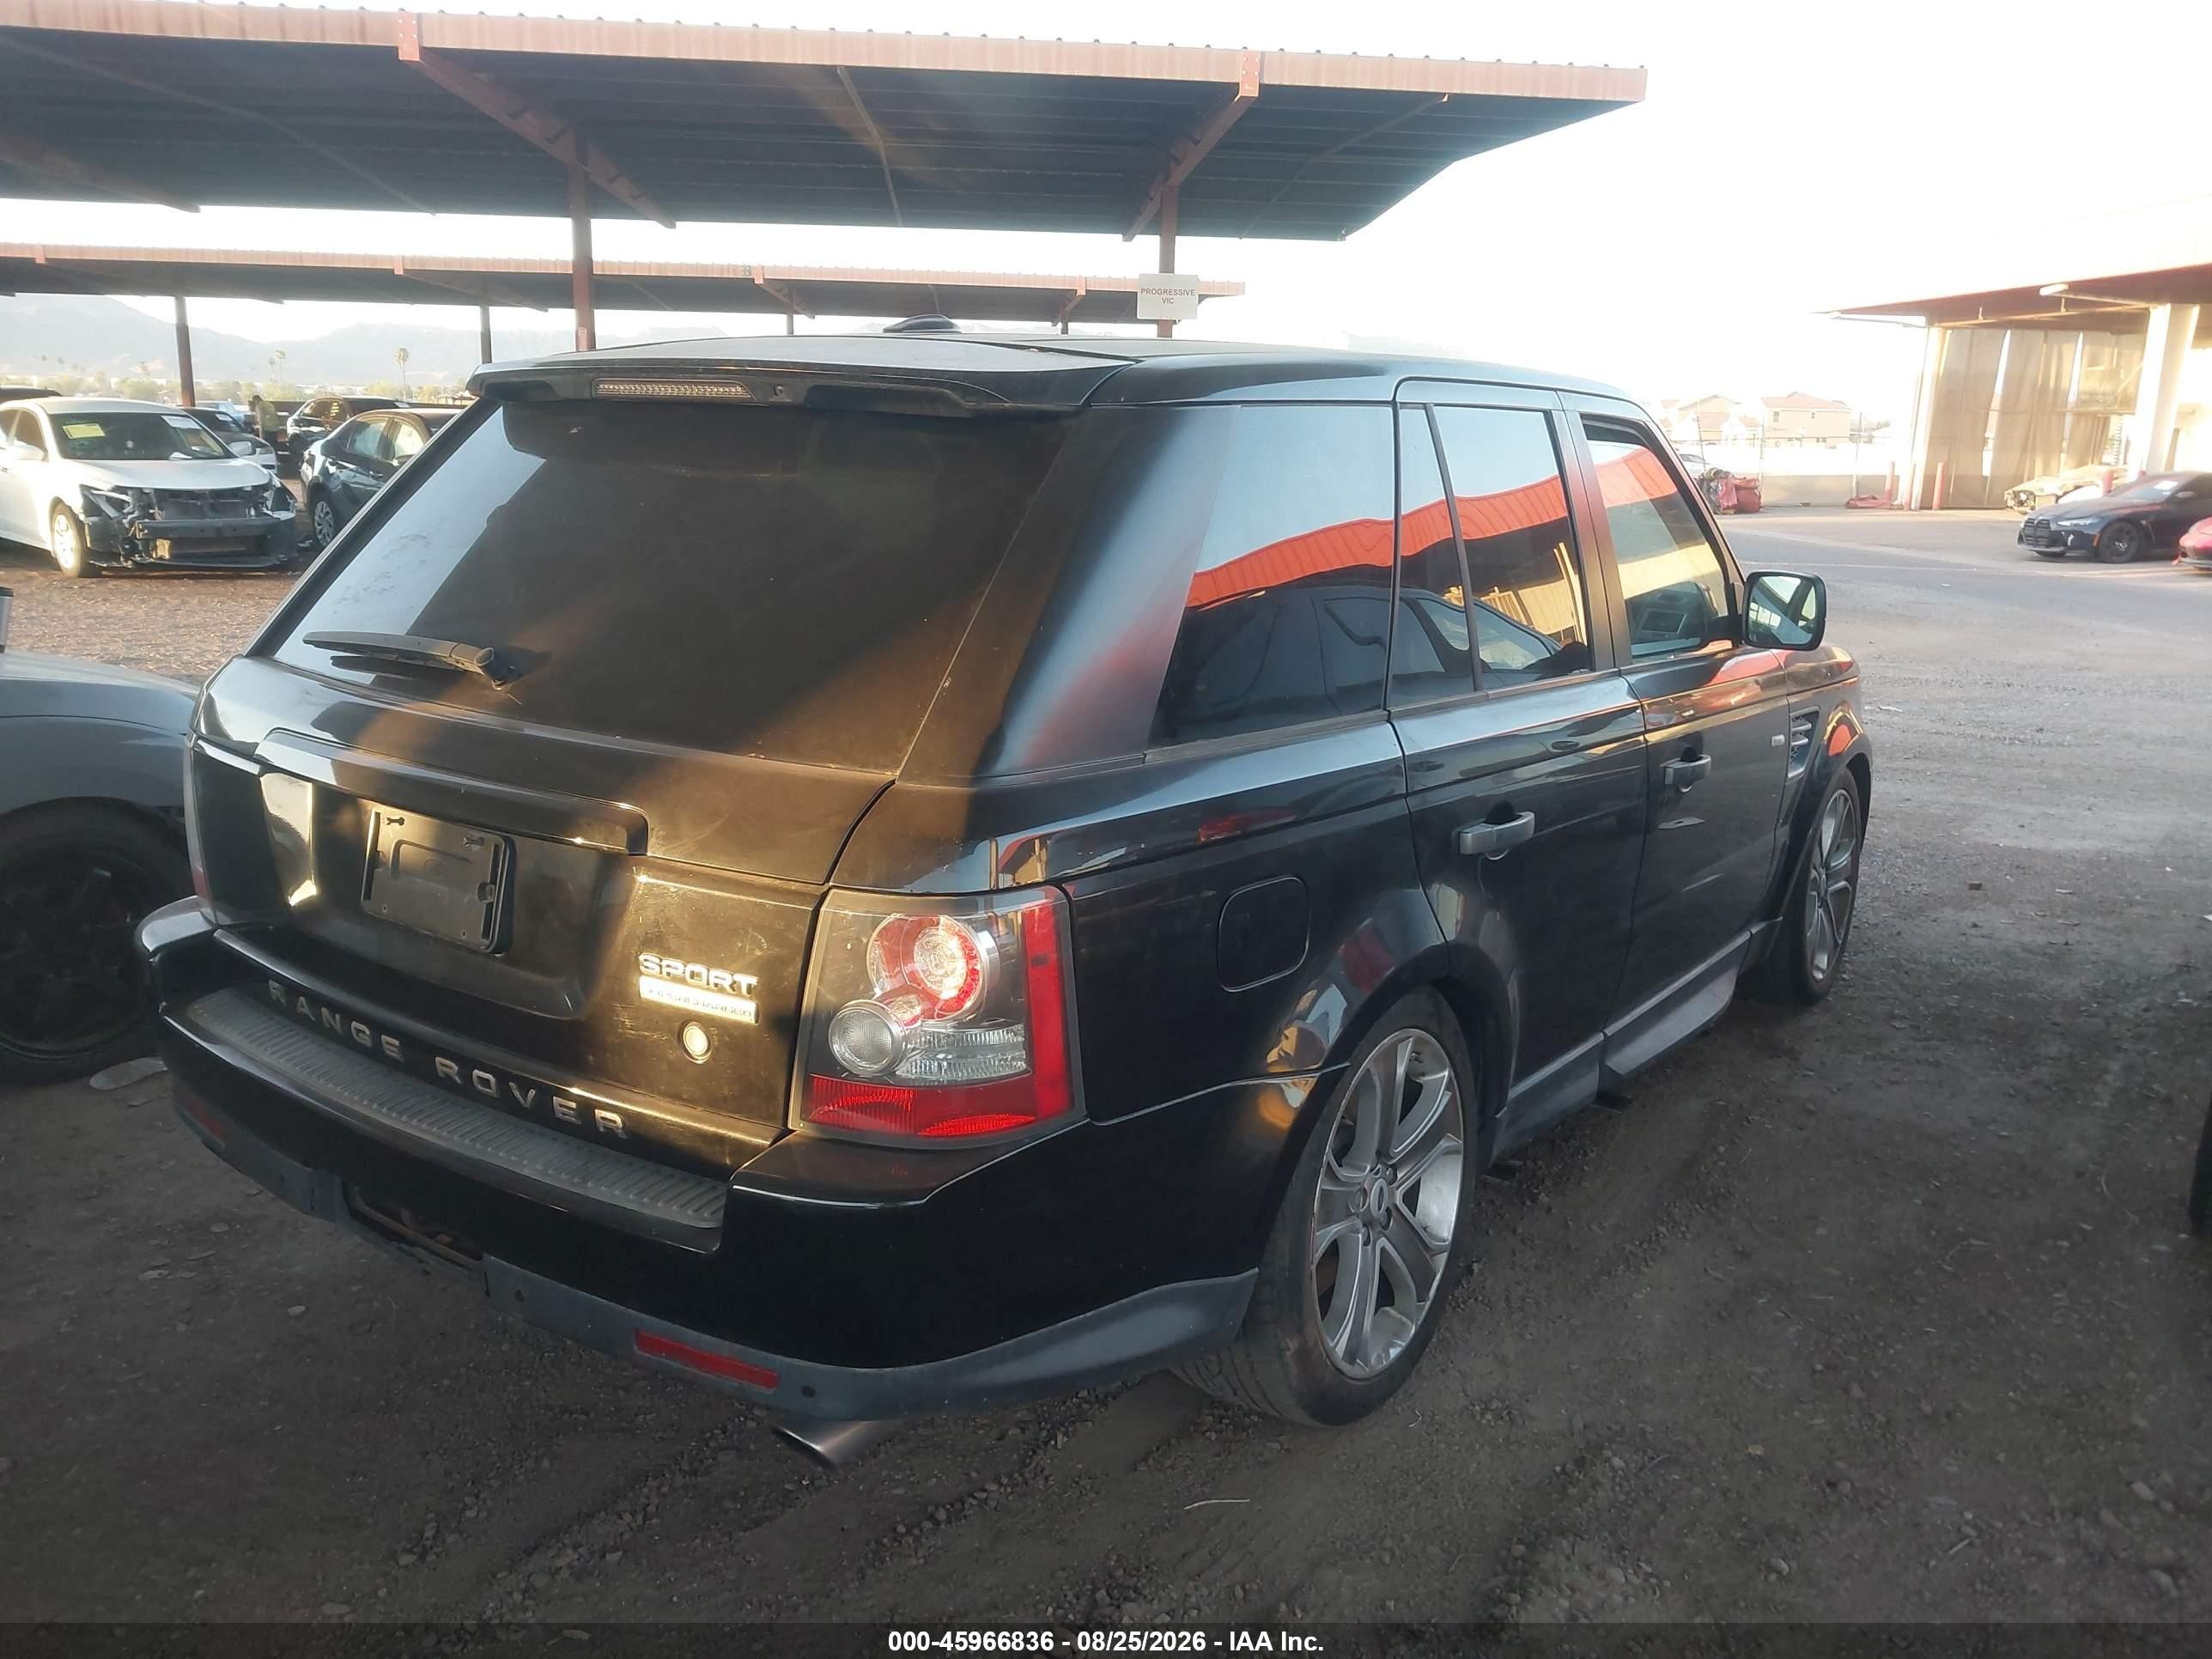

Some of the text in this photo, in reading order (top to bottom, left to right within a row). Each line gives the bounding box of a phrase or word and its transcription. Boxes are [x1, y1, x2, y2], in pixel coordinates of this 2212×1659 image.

[1140, 288, 1196, 296] PROGRESSIVE
[638, 952, 759, 998] SPORT
[268, 978, 627, 1139] RANGE ROVER
